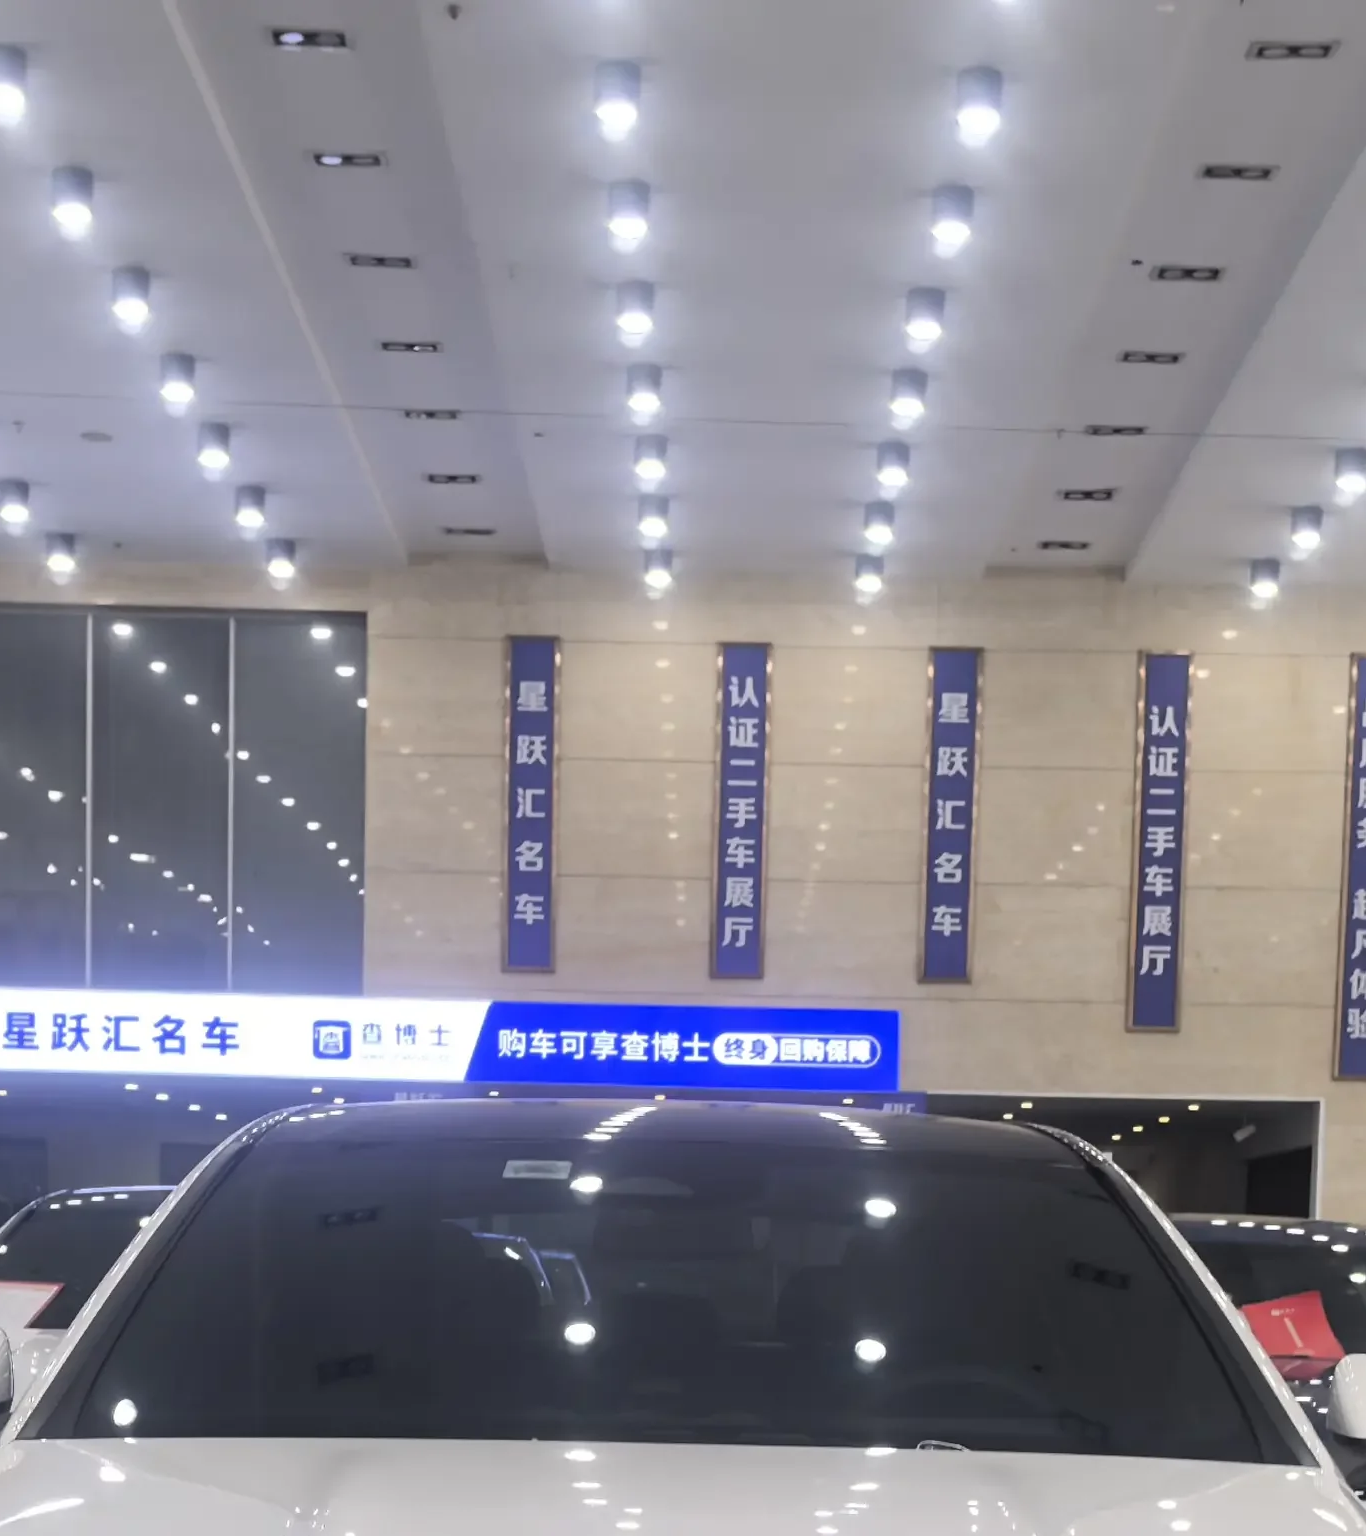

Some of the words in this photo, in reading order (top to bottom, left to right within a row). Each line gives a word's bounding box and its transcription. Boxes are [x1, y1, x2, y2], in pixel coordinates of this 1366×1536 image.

[515, 681, 549, 925] 星跃汇名车
[722, 676, 761, 948] 认证二手车展厅
[931, 692, 971, 937] 星跃汇名车
[1140, 706, 1179, 976] 认证二手车展厅
[1, 1011, 240, 1056] 星跃汇名车
